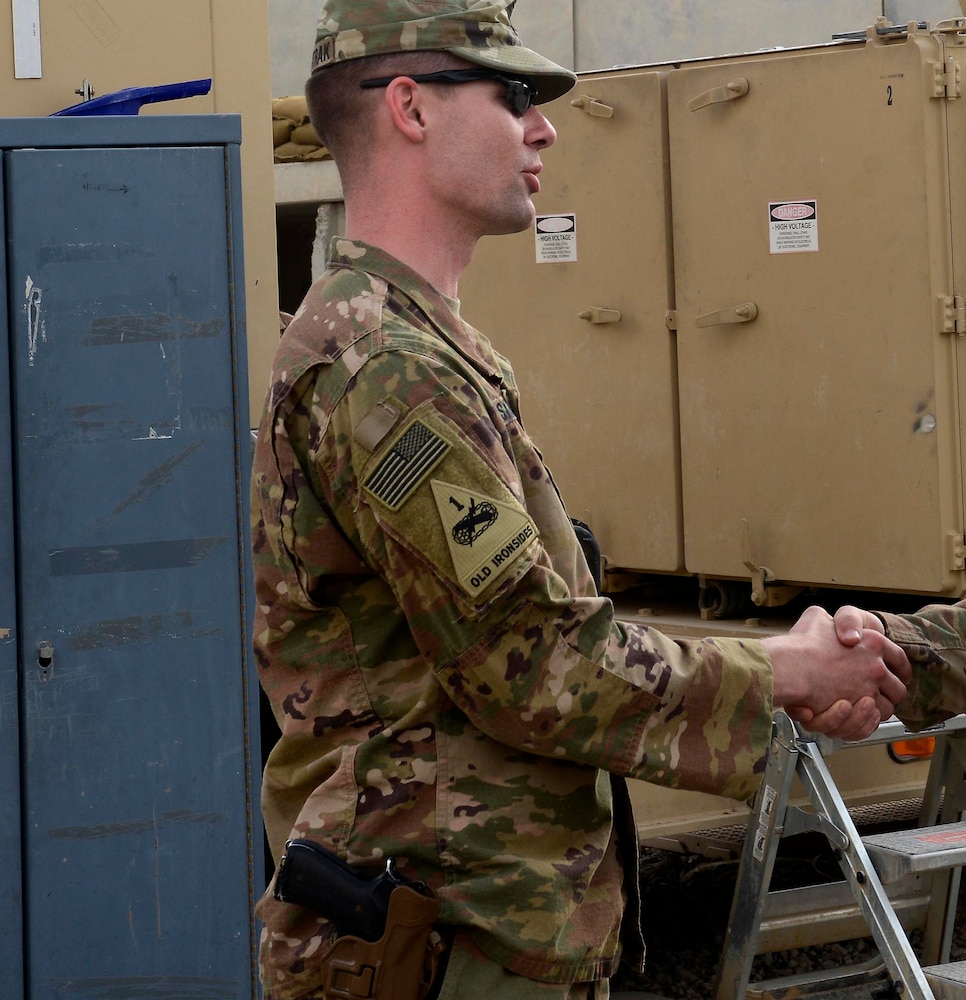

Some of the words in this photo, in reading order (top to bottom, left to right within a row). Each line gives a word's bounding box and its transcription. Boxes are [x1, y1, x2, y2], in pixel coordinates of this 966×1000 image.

[886, 85, 893, 106] 2
[778, 206, 807, 218] DANGER
[789, 222, 812, 230] VOLTAGE
[449, 496, 465, 512] 1
[470, 566, 492, 588] OLD
[491, 525, 533, 568] IRONSIDES
